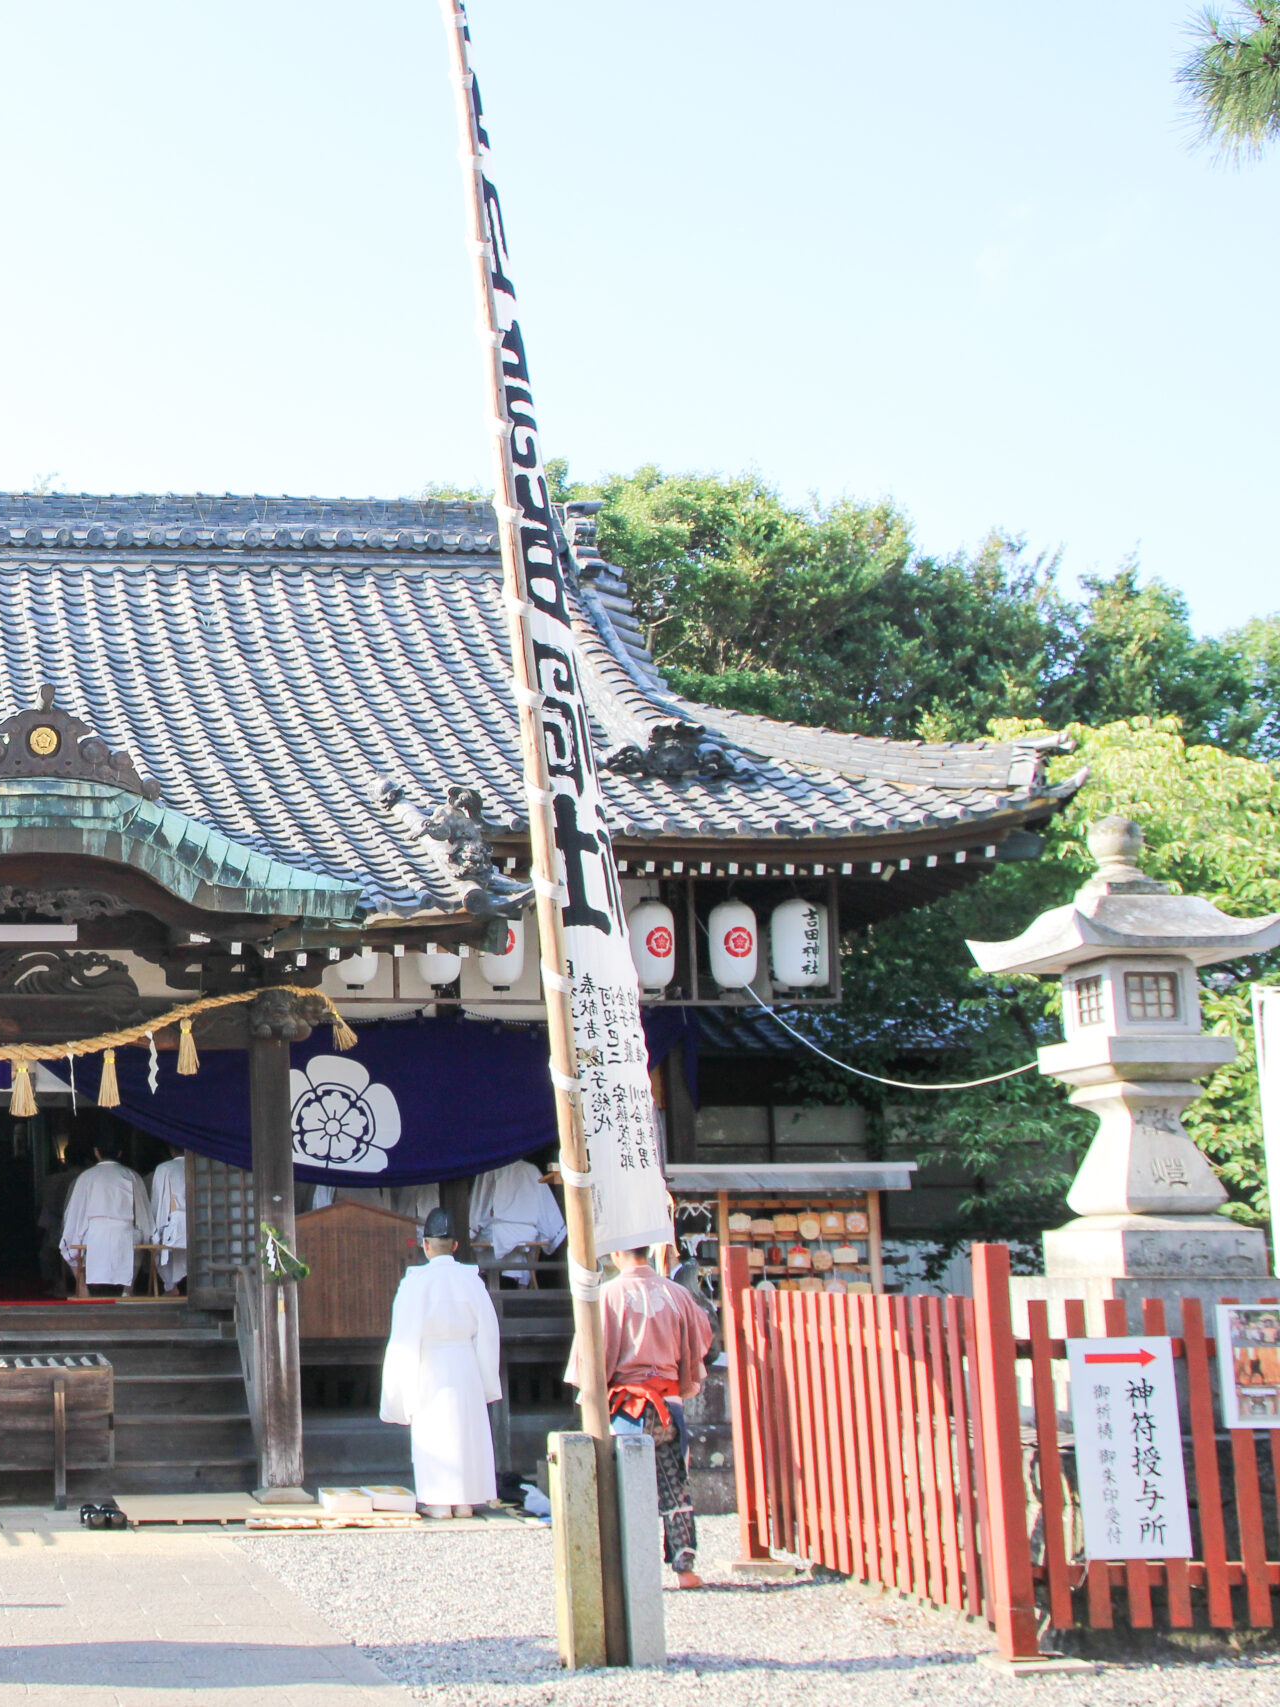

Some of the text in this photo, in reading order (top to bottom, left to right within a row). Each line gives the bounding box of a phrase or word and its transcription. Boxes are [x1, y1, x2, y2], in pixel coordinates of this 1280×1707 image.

[801, 908, 819, 976] 吉田神社
[1124, 1377, 1168, 1547] 神符授与所
